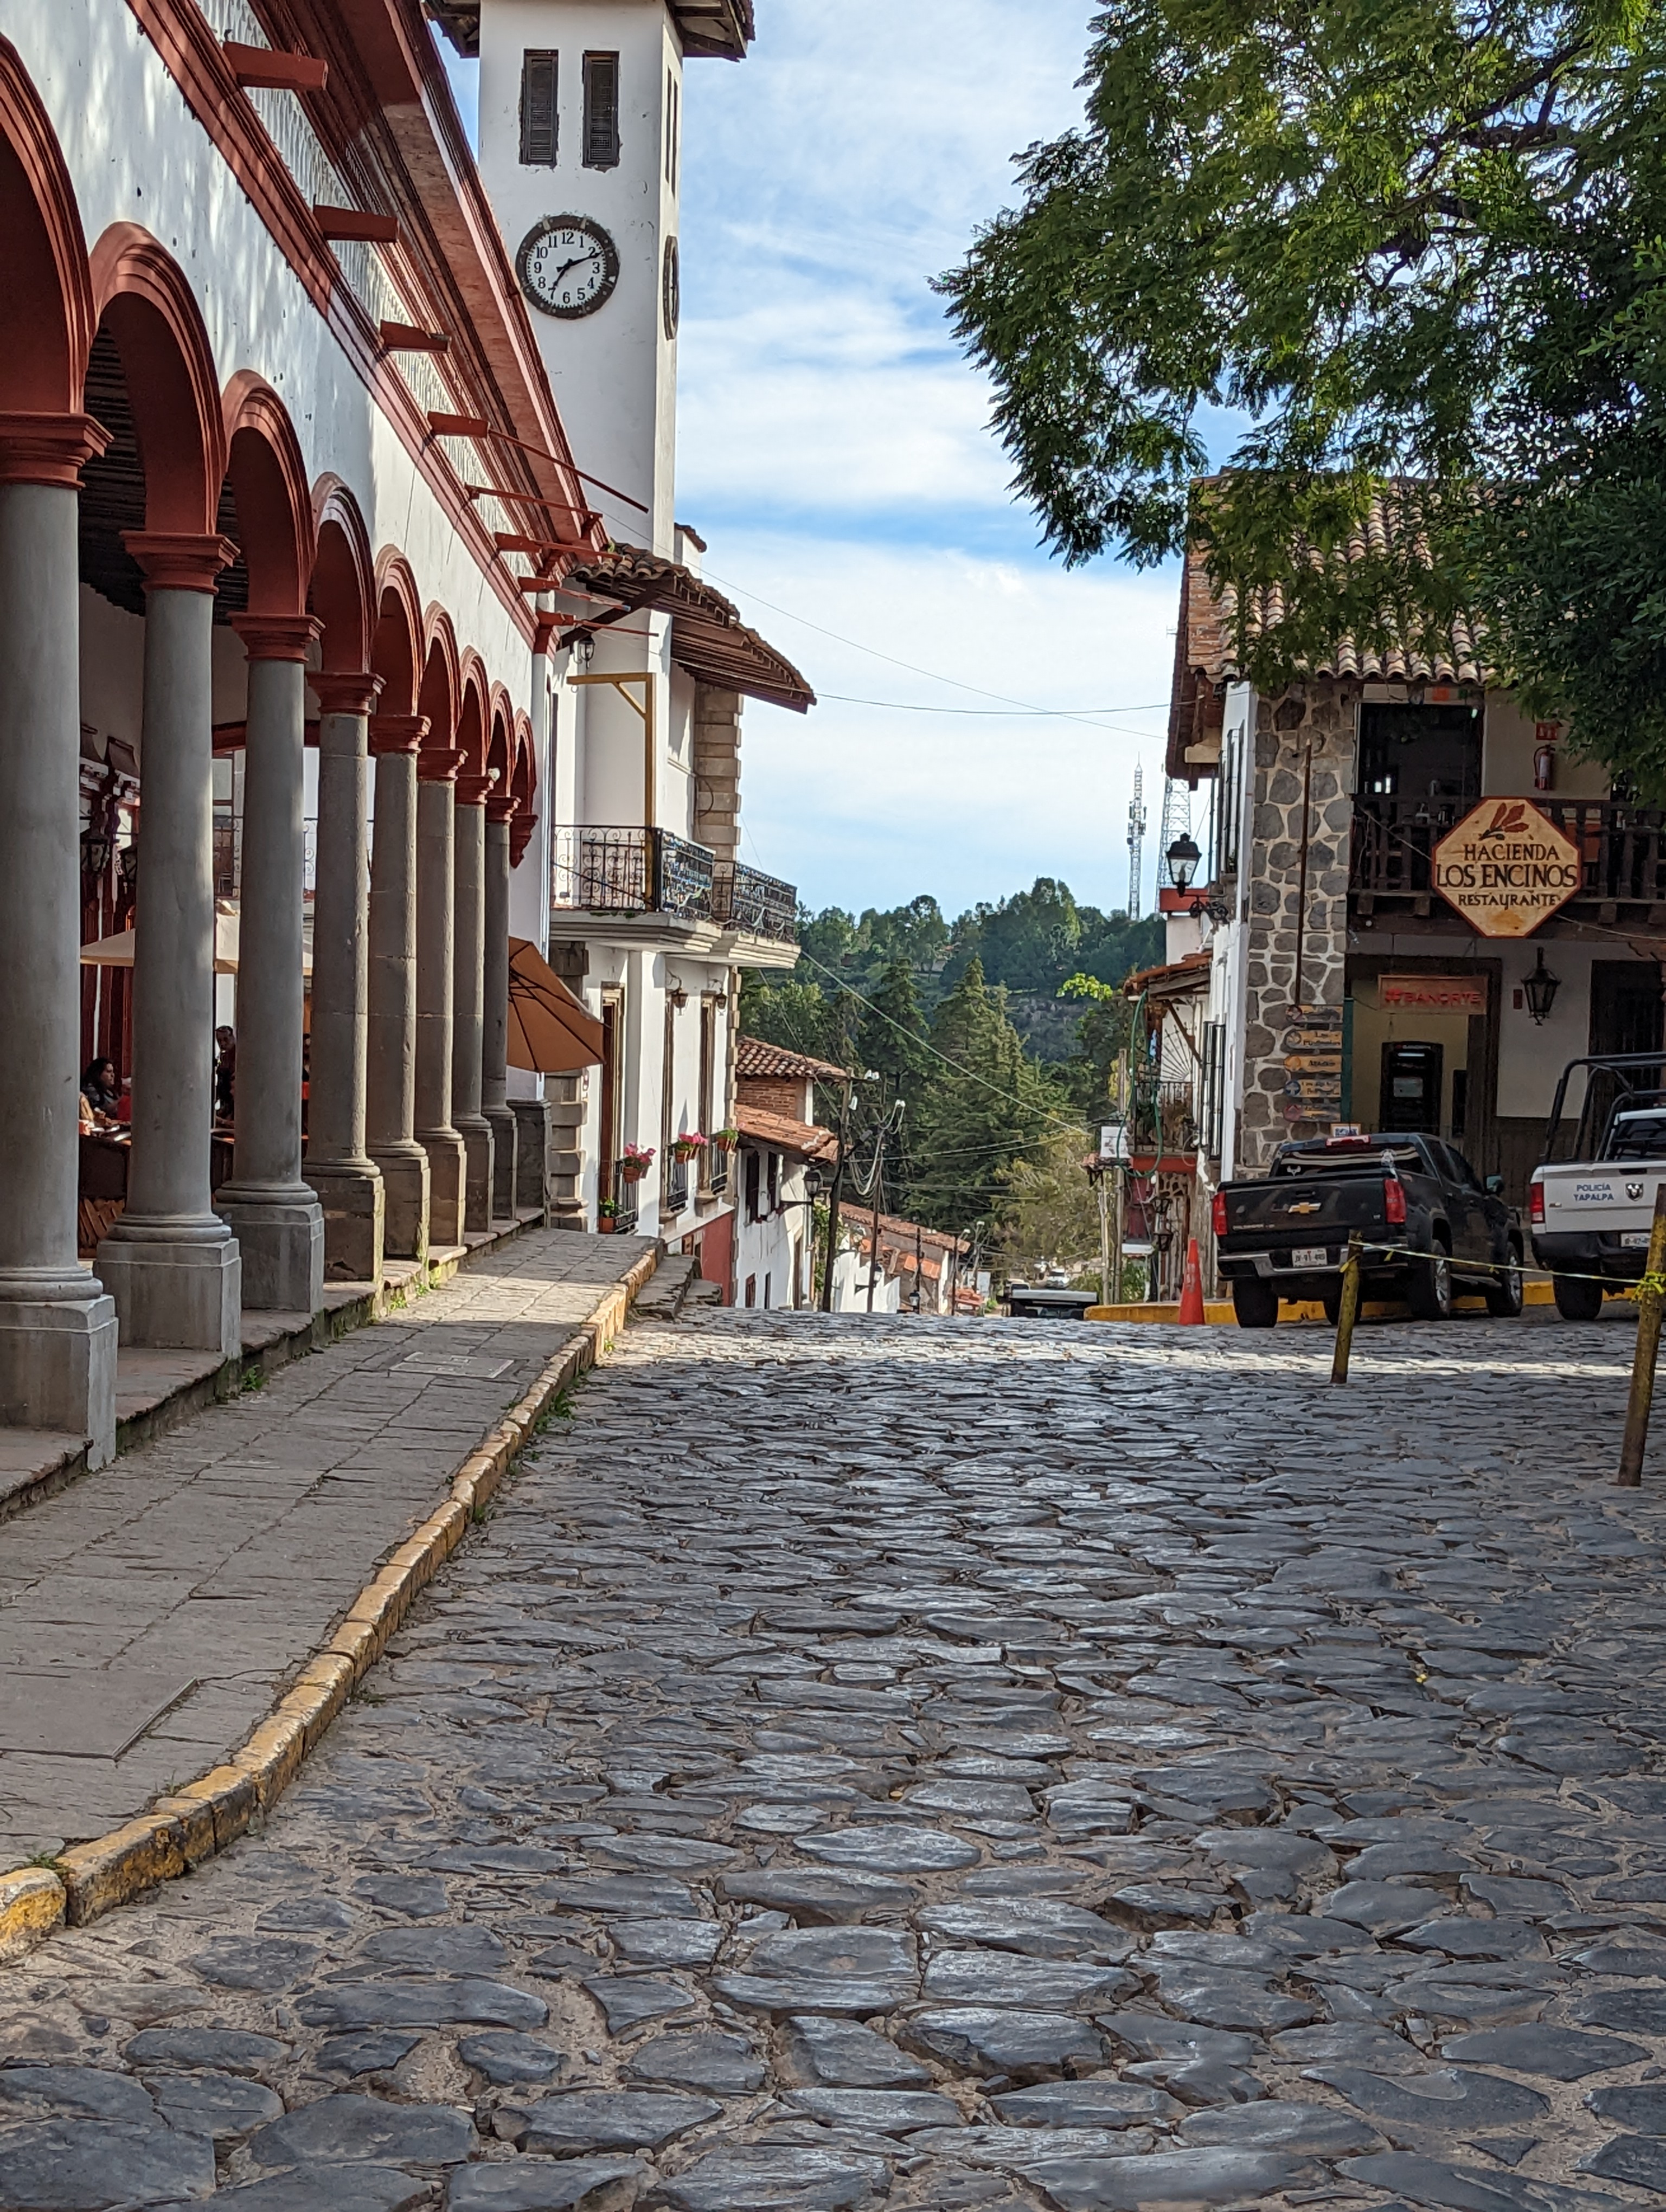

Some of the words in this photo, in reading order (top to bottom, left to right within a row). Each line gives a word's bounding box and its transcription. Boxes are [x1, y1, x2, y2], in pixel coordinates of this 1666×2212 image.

[548, 235, 558, 248] 11
[562, 232, 574, 244] 12
[579, 236, 584, 248] 1
[536, 247, 548, 258] 10
[588, 247, 597, 258] 2
[534, 262, 542, 273] 9
[592, 262, 600, 274] 3
[538, 277, 546, 288] 8
[587, 278, 594, 289] 4
[548, 287, 556, 300] 7
[562, 292, 570, 304] 6
[577, 288, 585, 300] 5
[1464, 844, 1560, 861] HACIENDA
[1437, 864, 1476, 888] LOS
[1480, 864, 1577, 888] ENCINOS
[1458, 894, 1556, 910] RESTAURANTE
[1577, 1182, 1611, 1192] POLICÍA
